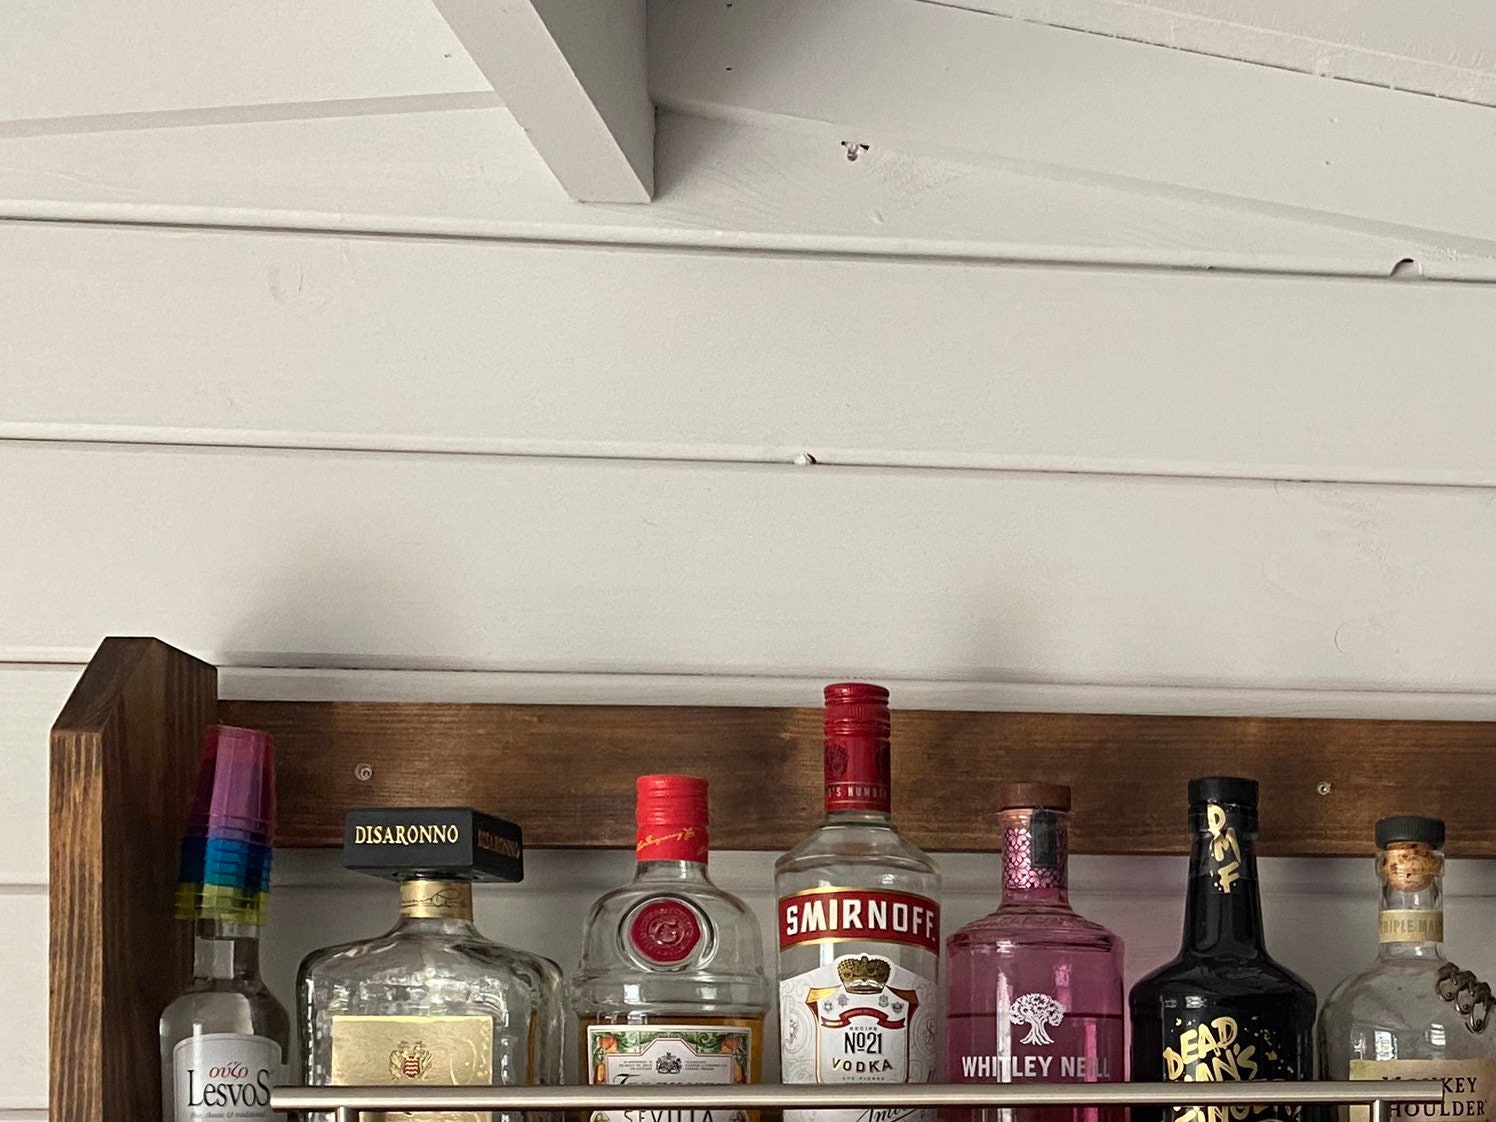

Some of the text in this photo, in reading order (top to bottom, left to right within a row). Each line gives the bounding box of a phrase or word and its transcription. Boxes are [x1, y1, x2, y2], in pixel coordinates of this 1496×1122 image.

[354, 825, 459, 845] DISARONNO
[1380, 920, 1413, 934] RIPLE
[1163, 1016, 1238, 1080] DEAD
[832, 1057, 894, 1073] VODKA
[962, 1056, 1053, 1078] WHITLEY
[1184, 1043, 1258, 1082] AN'S
[1390, 1101, 1484, 1117] HOULDER
